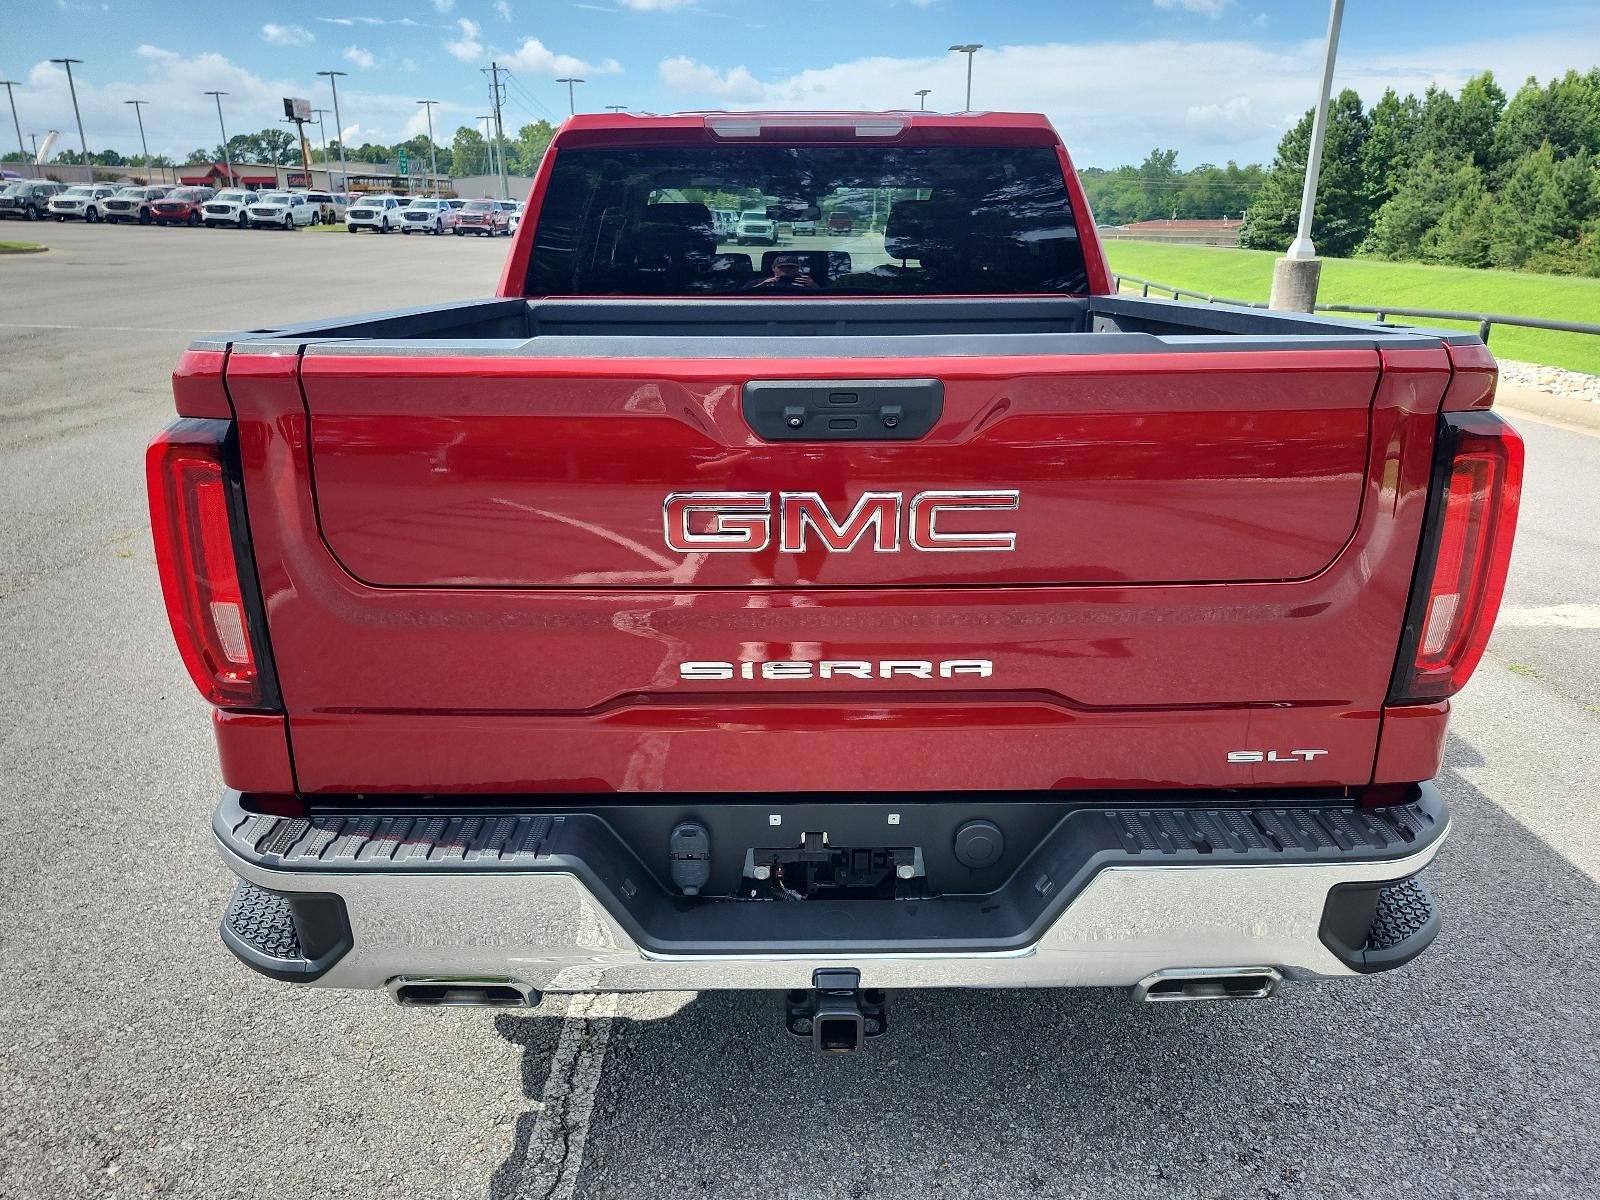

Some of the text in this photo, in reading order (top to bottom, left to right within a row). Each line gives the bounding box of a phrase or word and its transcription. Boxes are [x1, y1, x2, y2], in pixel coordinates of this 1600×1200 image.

[663, 490, 1019, 553] GMC
[680, 659, 993, 680] SIERRA
[1227, 749, 1329, 763] SLT
